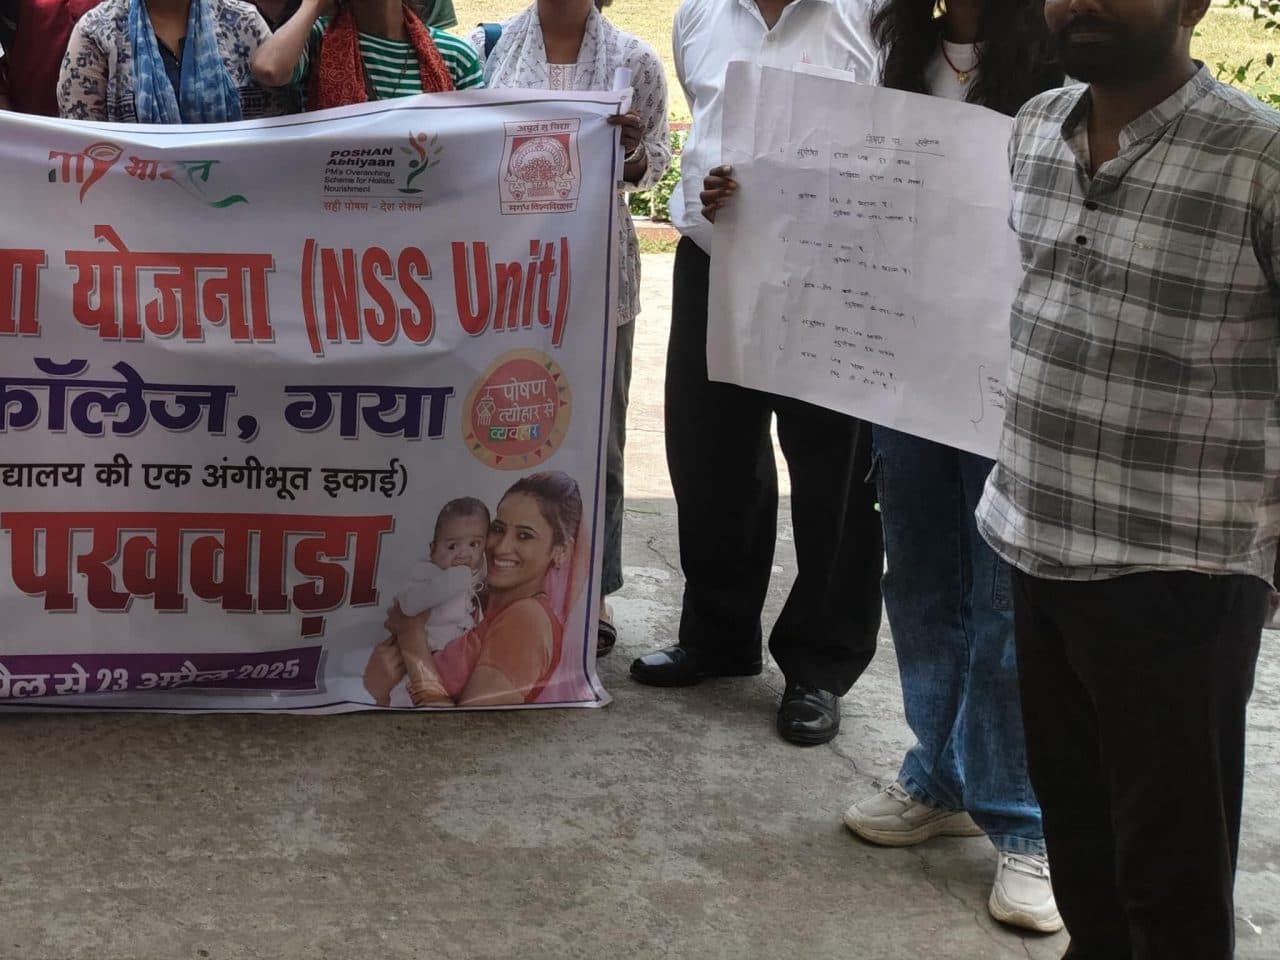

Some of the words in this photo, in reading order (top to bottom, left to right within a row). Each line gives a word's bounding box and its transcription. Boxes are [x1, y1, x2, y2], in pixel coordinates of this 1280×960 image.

[325, 157, 395, 169] Abhiyaan
[330, 147, 393, 159] POSHAN
[323, 184, 371, 193] Nourishment
[355, 176, 367, 185] for
[64, 224, 274, 340] योजना
[301, 238, 433, 356] (NSS
[451, 236, 571, 347] Unit)
[503, 377, 548, 400] पोषण
[284, 384, 454, 439] गया
[498, 403, 541, 422] त्योहार
[543, 398, 555, 417] से
[95, 453, 132, 487] की
[141, 464, 192, 489] एक
[202, 456, 312, 500] अंगीभूत
[320, 458, 408, 497] इकाई)
[0, 512, 395, 639] पखवाड़ा
[54, 662, 90, 695] से
[96, 668, 128, 691] 23
[236, 659, 299, 680] 2025
